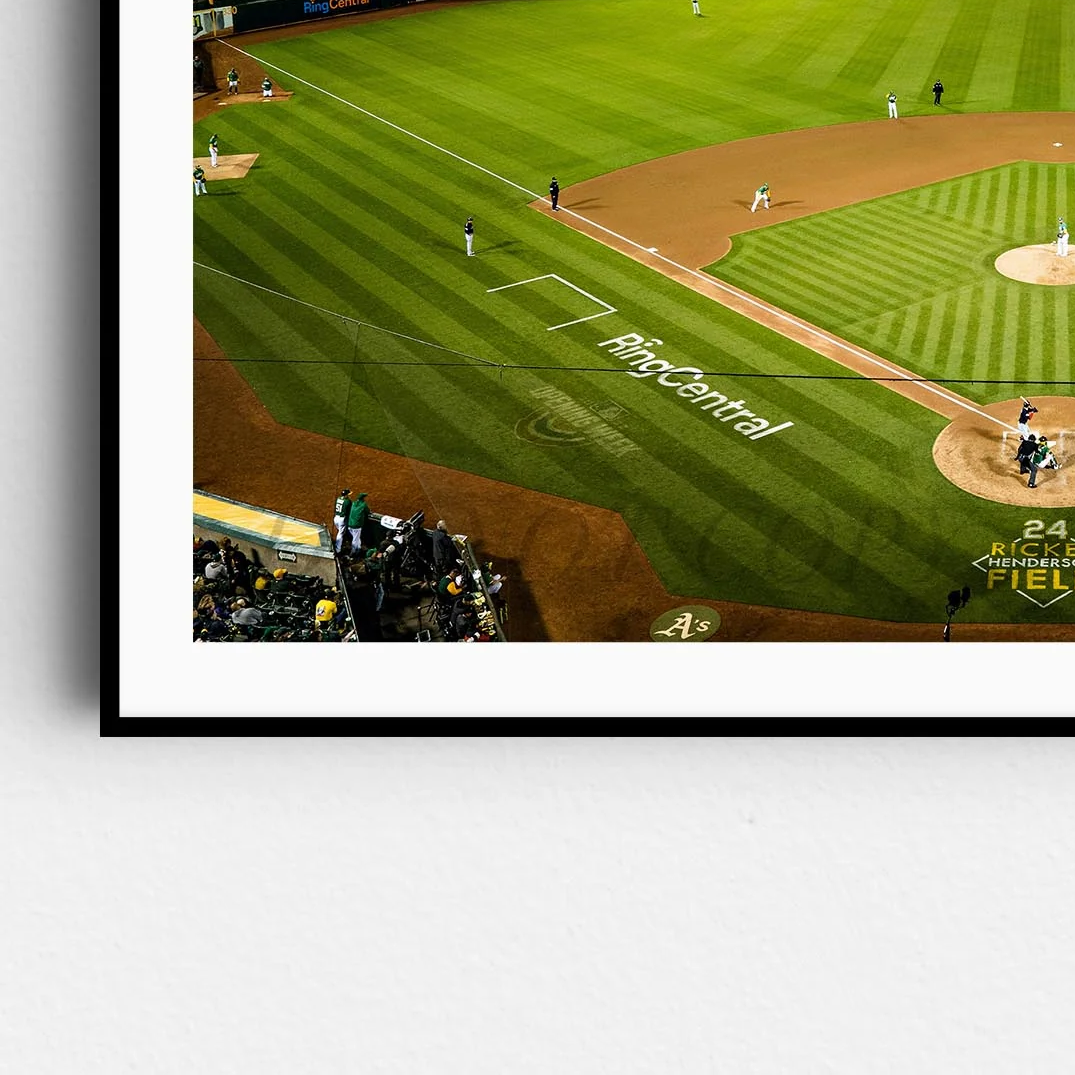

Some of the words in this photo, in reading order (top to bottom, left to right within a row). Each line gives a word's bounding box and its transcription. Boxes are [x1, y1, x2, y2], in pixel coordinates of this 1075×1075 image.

[597, 332, 795, 441] RingCentral
[1022, 519, 1068, 540] 24
[654, 612, 711, 639] A's
